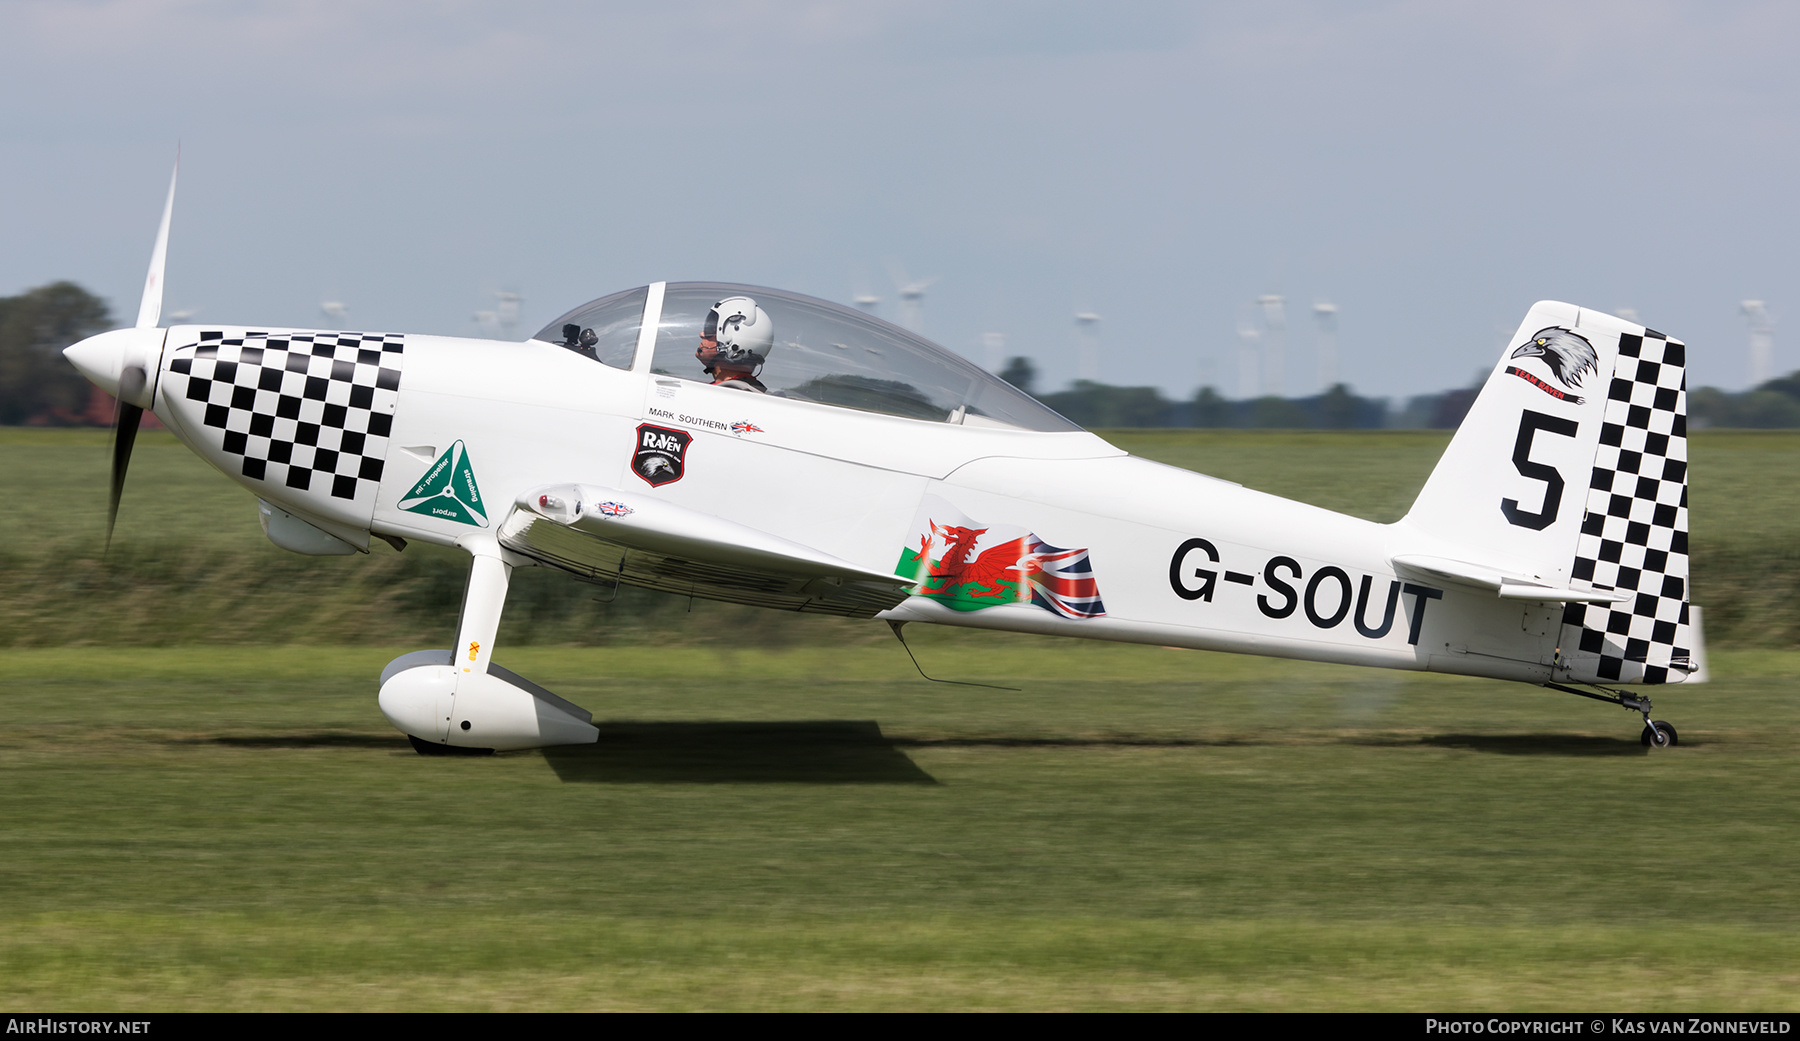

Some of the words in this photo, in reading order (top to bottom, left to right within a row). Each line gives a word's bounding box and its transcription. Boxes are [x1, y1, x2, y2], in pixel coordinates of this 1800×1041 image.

[1515, 368, 1538, 385] TEAM
[1538, 381, 1565, 400] RAVEN
[649, 407, 675, 419] MARK
[678, 414, 728, 430] SOUTHERN
[463, 469, 478, 502] straubing
[1500, 408, 1579, 531] 5
[432, 507, 457, 517] airport
[1169, 537, 1443, 646] G-SOUT
